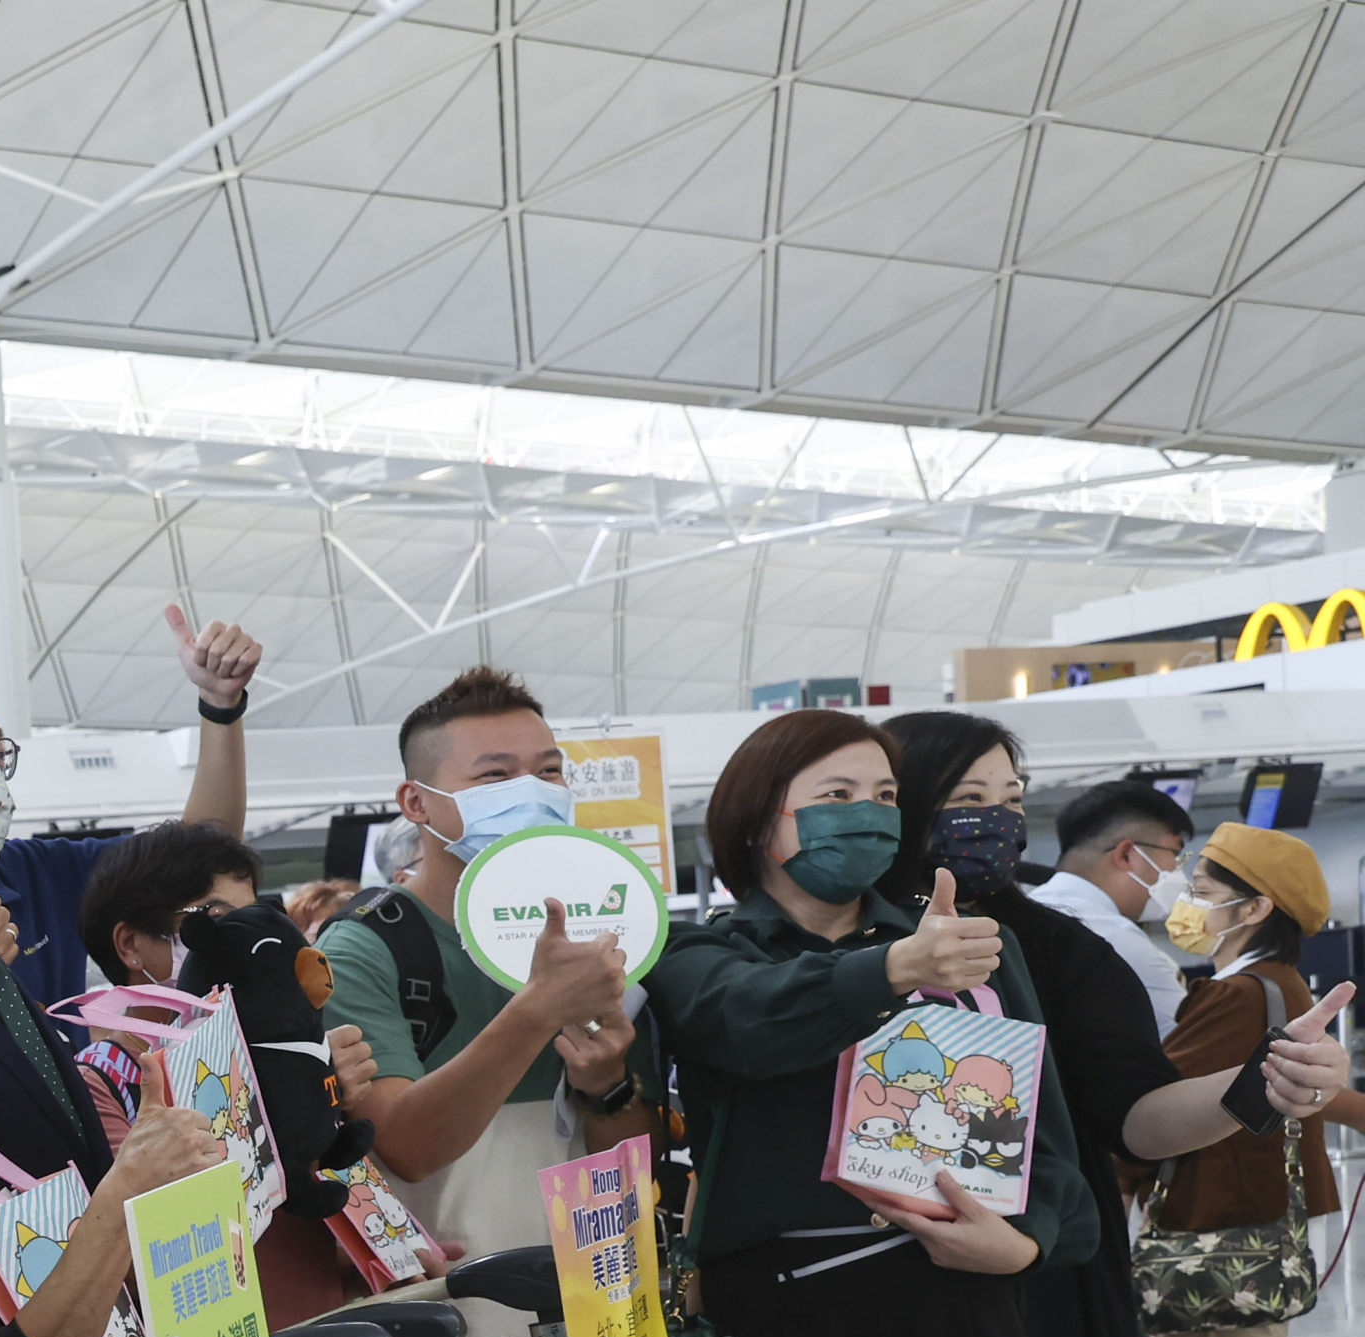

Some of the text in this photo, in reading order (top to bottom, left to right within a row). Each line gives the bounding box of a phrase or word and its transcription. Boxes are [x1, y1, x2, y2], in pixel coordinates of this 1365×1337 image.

[564, 760, 636, 785] 永安旅遊
[505, 932, 528, 941] STAR
[592, 1167, 621, 1197] Hong
[847, 1156, 930, 1189] sky shop
[149, 1213, 224, 1279] Miramar Travel
[170, 1257, 233, 1324] 美麗華旅遊
